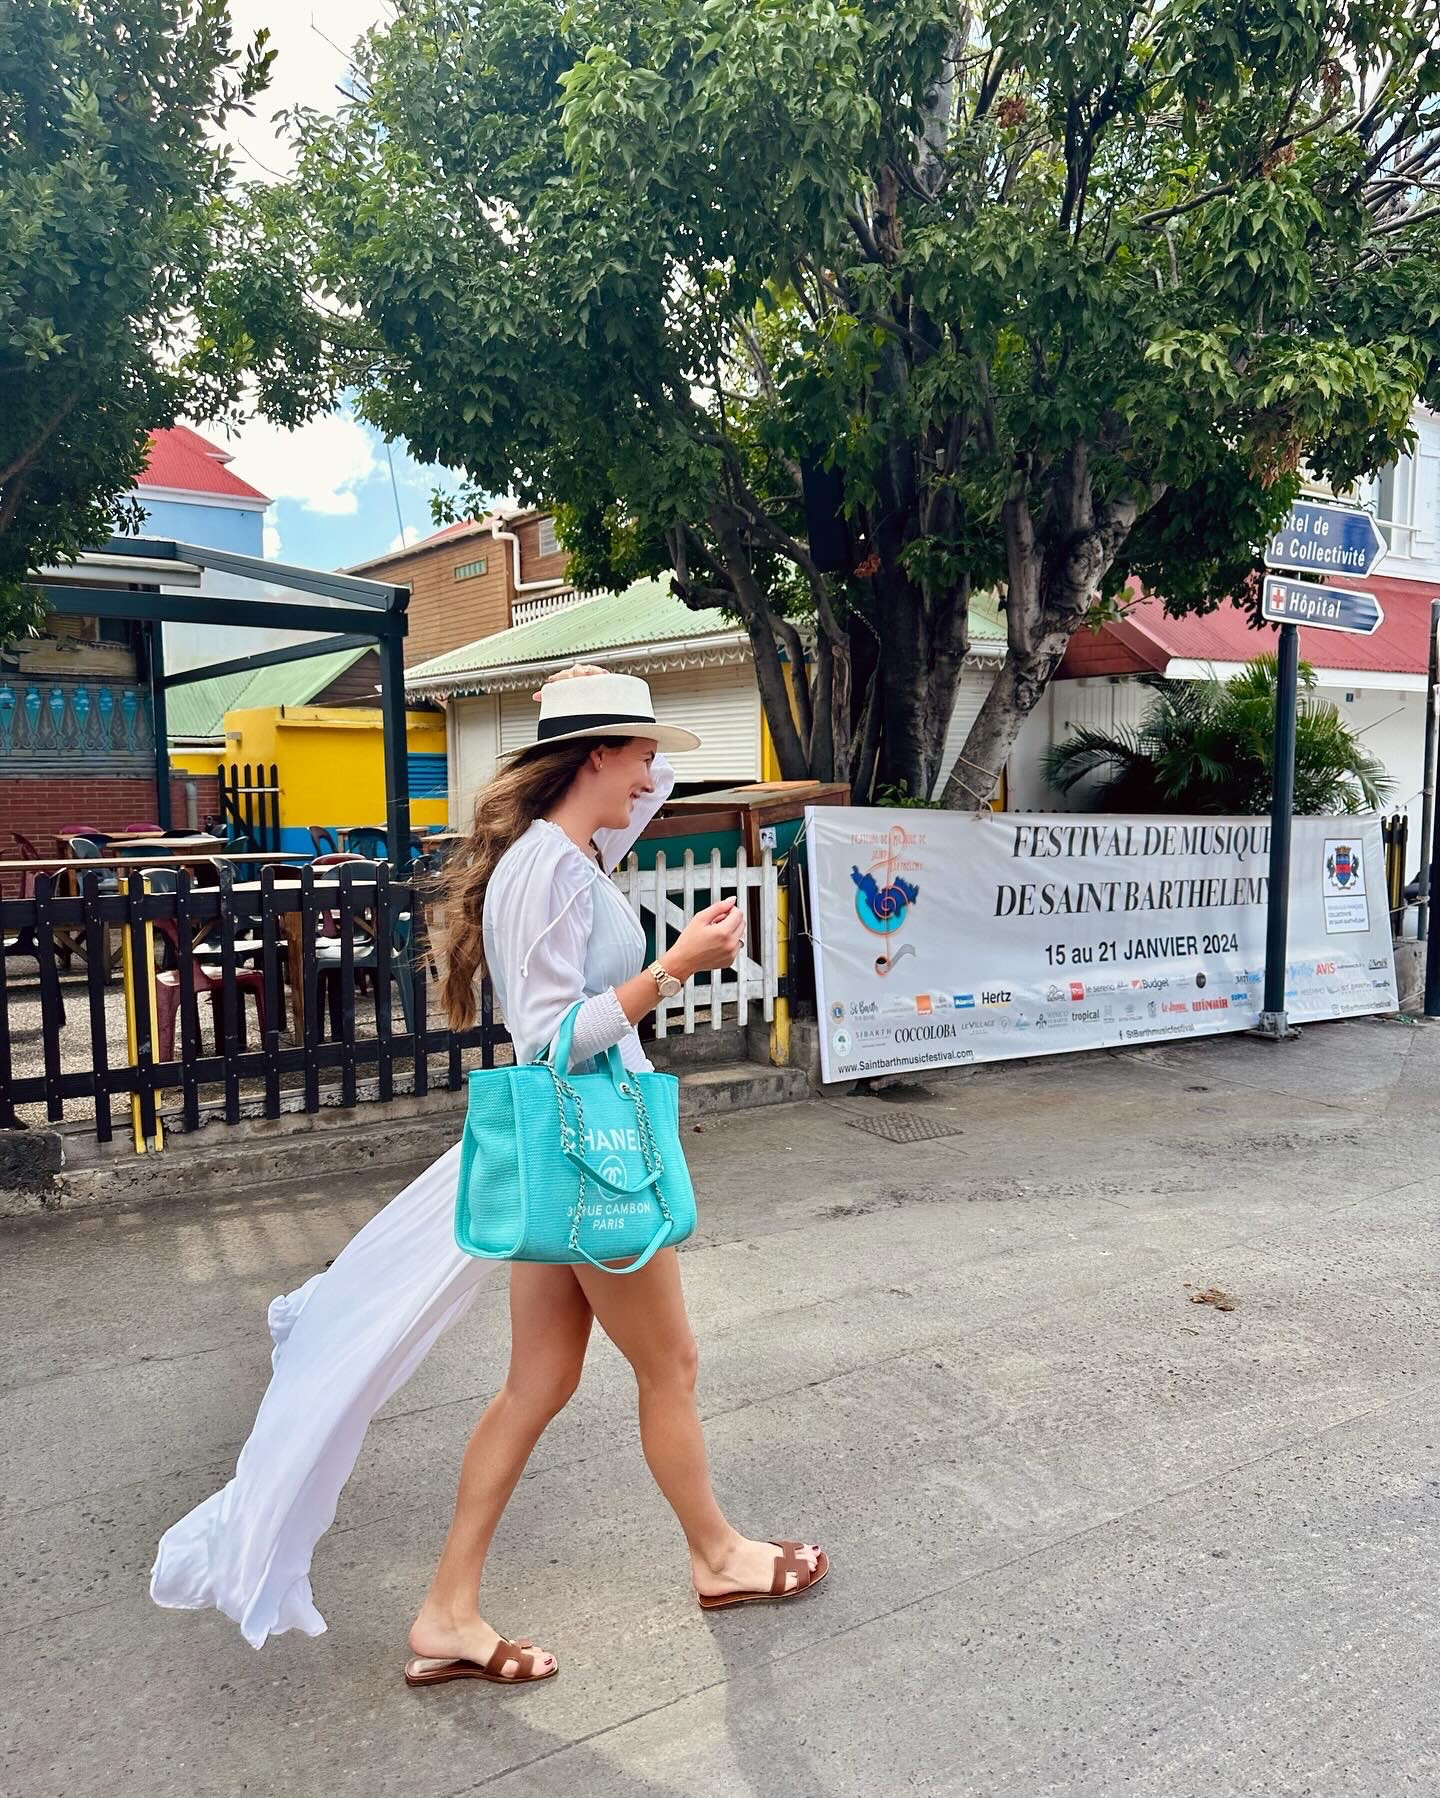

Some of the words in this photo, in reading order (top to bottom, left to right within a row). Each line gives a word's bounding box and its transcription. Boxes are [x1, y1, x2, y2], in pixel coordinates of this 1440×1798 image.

[1313, 515, 1329, 536] de
[1271, 534, 1284, 556] la
[1289, 538, 1366, 567] Collectivité
[1289, 591, 1341, 619] Hôpital
[1011, 826, 1138, 857] FESTIVAL
[1143, 826, 1176, 856] DE
[993, 885, 1036, 916] DE
[1039, 881, 1120, 915] SAINT
[1045, 944, 1066, 965] 15
[1071, 946, 1092, 964] au
[1098, 941, 1117, 961] 21
[1124, 936, 1198, 960] JANVIER
[1202, 933, 1239, 954] 2024
[1316, 961, 1336, 975] AVIS
[1142, 978, 1169, 990] Budget
[981, 990, 1011, 1004] Hertz
[1072, 1009, 1100, 1022] tropical
[894, 1024, 956, 1043] COCCOLOBA
[838, 1049, 973, 1073] www.Saintbarthmusicfestival.com
[606, 1202, 651, 1215] CAMBON
[593, 1218, 625, 1230] PARIS
